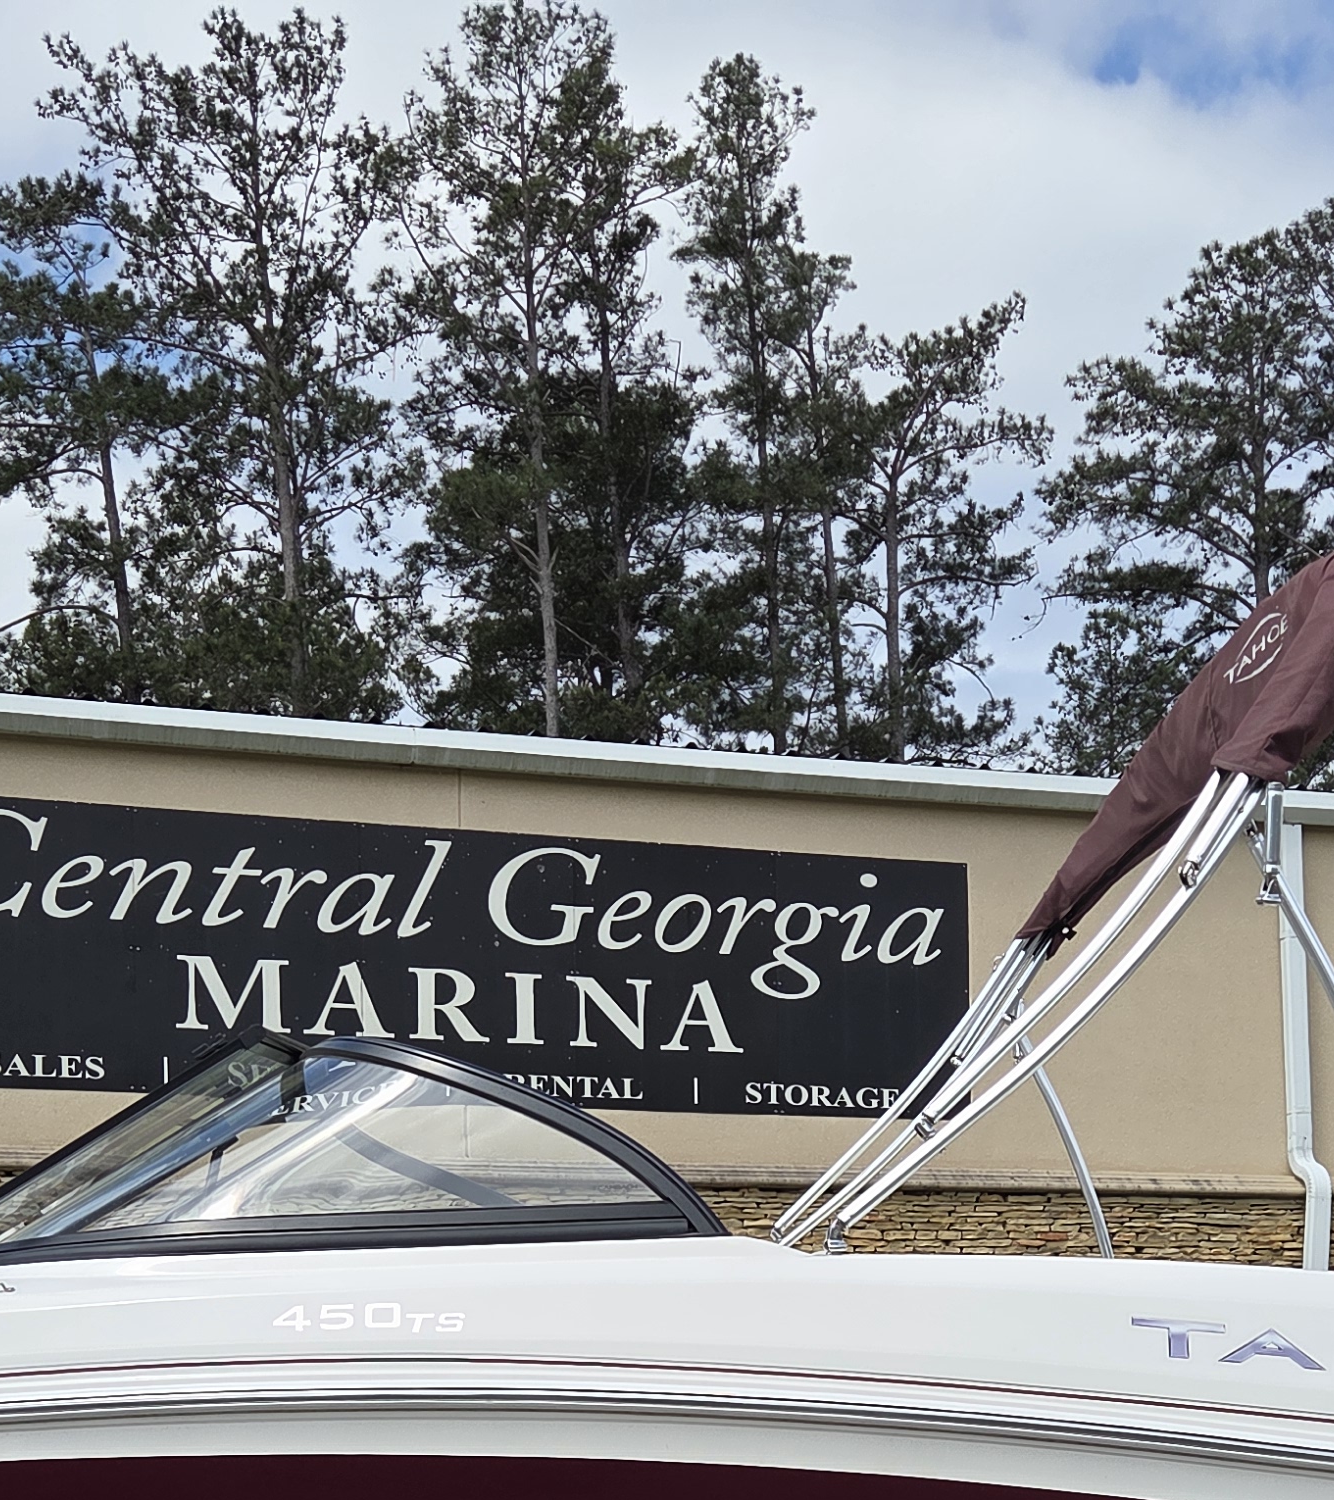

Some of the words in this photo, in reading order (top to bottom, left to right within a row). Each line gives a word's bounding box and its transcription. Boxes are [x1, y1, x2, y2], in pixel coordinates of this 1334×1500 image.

[1222, 613, 1289, 685] TAHOE
[487, 846, 945, 1000] Georgia
[175, 953, 745, 1054] MARINA
[745, 1081, 899, 1110] STORAGE
